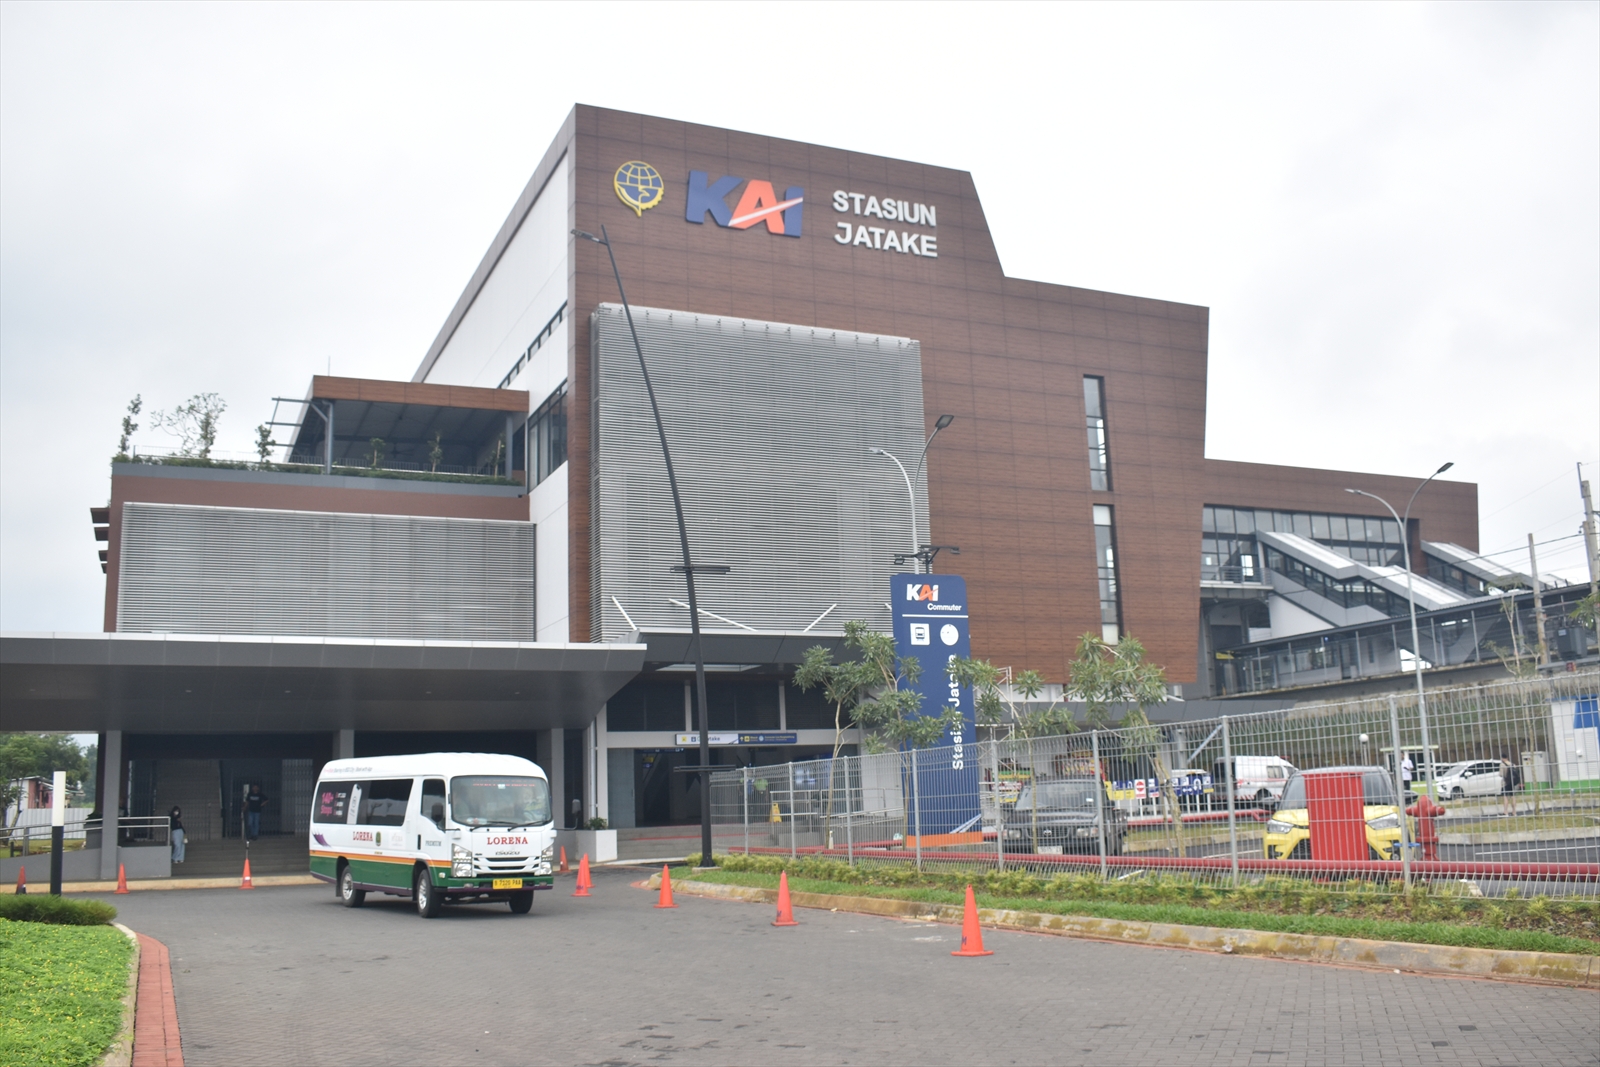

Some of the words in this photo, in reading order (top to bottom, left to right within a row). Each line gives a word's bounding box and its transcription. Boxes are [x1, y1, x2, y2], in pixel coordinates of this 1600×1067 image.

[685, 169, 804, 238] KAI
[832, 189, 937, 227] STASIUN
[834, 222, 938, 258] JATAKE
[906, 583, 939, 602] KAI
[927, 602, 962, 611] Commuter
[352, 831, 373, 842] LORENA
[487, 836, 528, 845] LORENA
